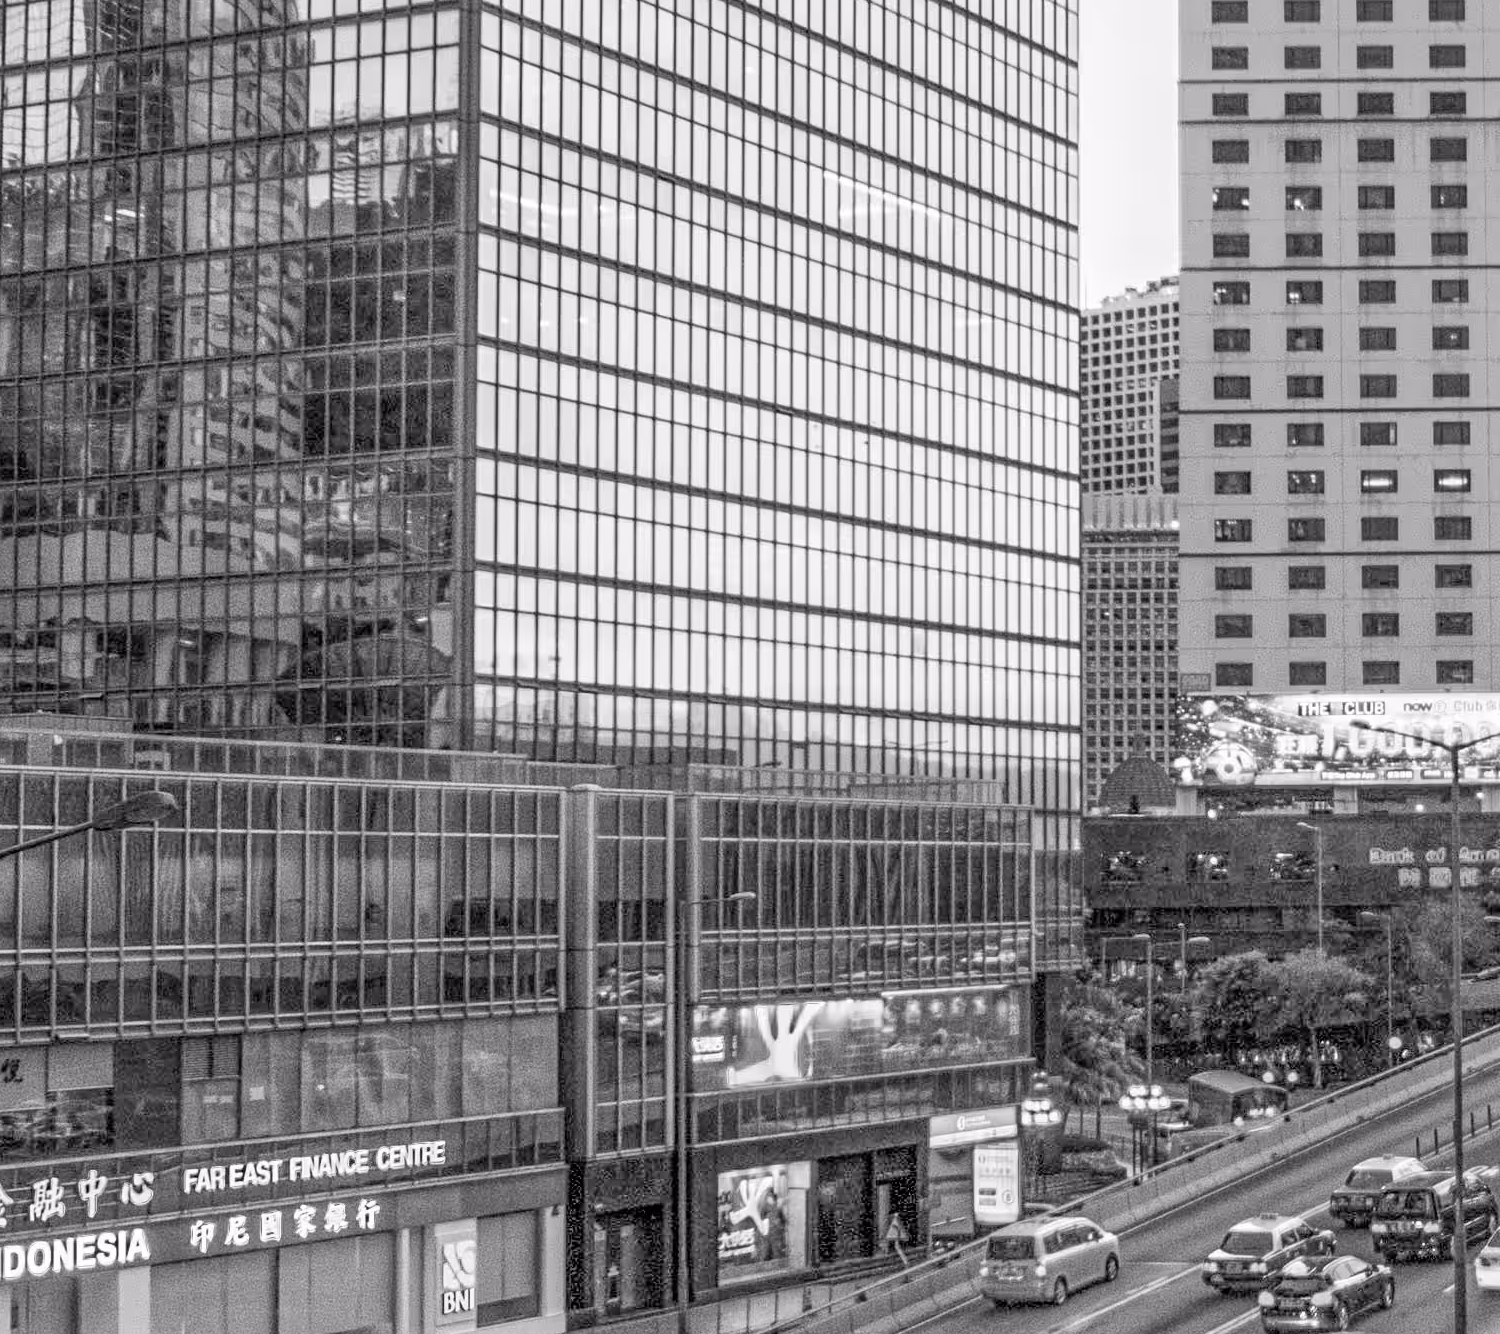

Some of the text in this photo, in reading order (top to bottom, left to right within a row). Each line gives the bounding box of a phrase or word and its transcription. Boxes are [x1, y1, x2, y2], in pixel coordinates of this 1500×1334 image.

[1298, 701, 1330, 716] THE
[1342, 701, 1385, 716] CLUB
[1403, 702, 1432, 712] now
[184, 1140, 446, 1195] FAR EAST FINANCE CENTRE
[442, 1287, 476, 1316] BNI
